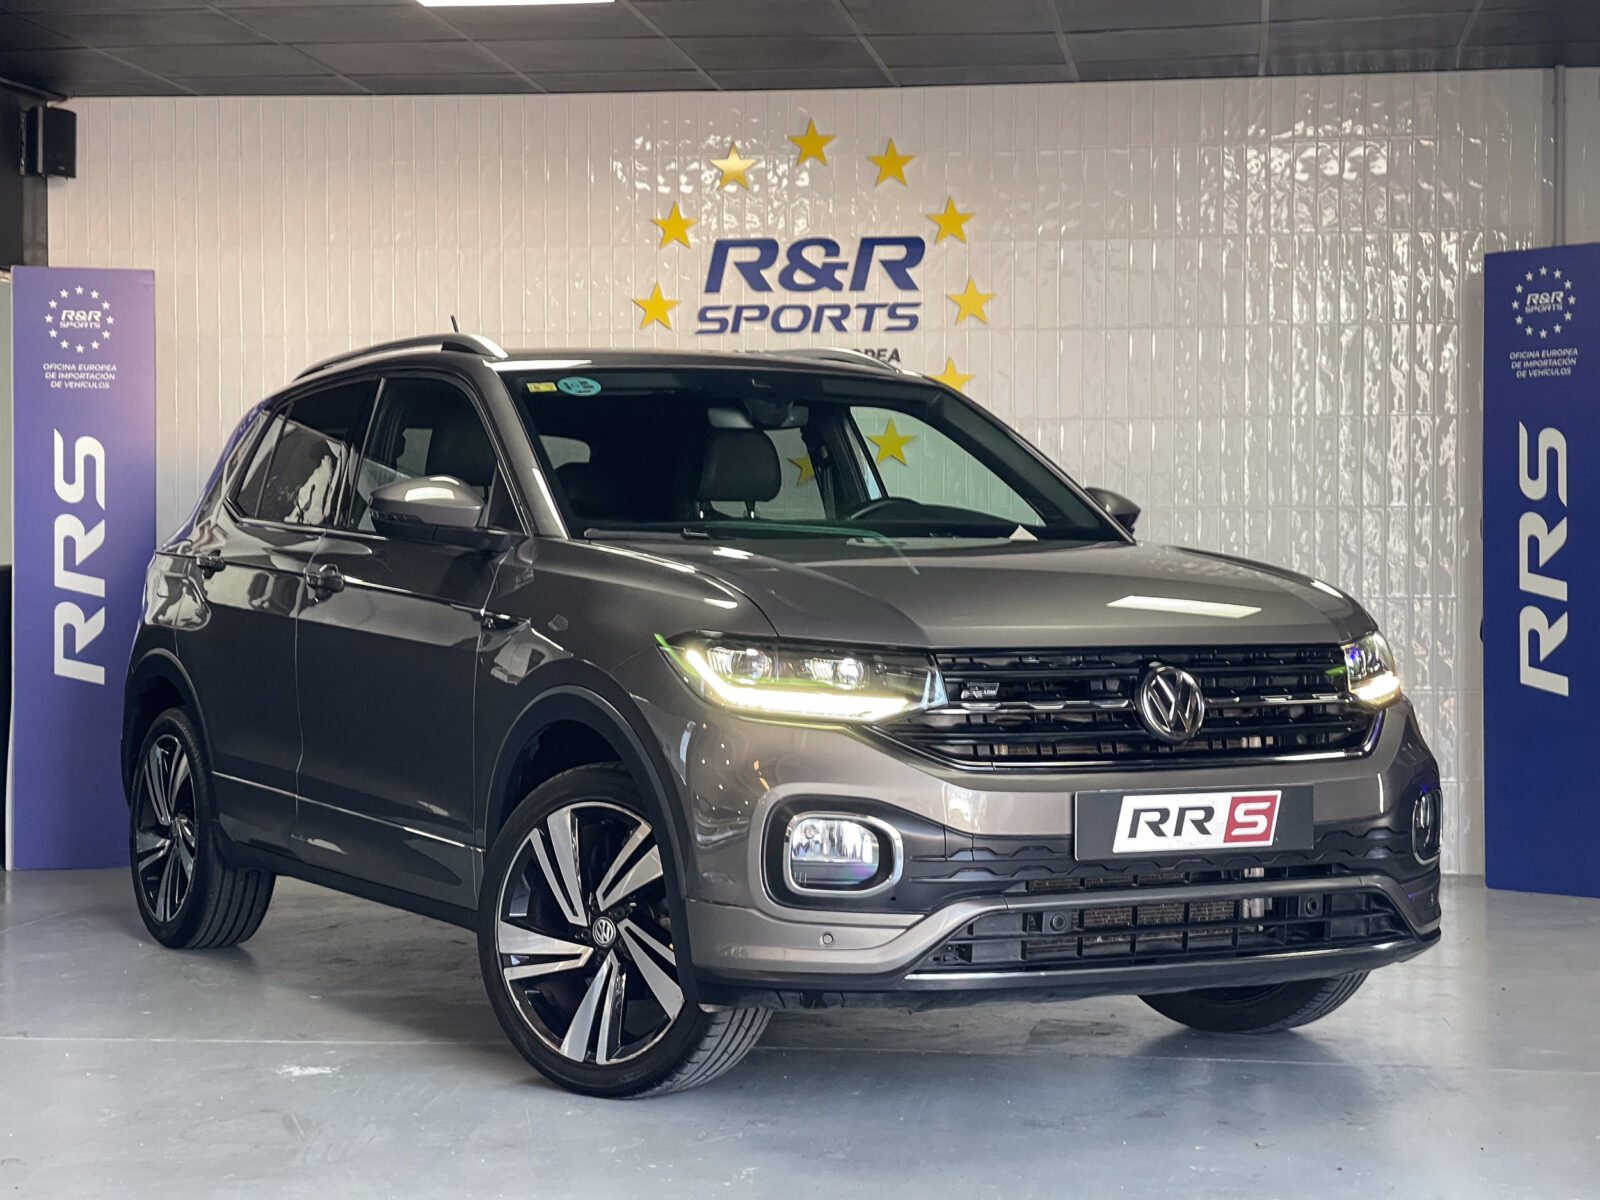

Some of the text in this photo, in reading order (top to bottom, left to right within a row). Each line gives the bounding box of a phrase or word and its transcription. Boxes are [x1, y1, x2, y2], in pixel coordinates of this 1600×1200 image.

[704, 236, 926, 293] R&R
[1527, 291, 1564, 305] R&R
[1525, 303, 1563, 313] SPORTS
[61, 309, 102, 322] R&R
[695, 302, 922, 335] SPORTS
[59, 321, 101, 329] SPORTS
[1509, 347, 1578, 360] OFICINA EUROPEA
[43, 363, 117, 372] OFICINA EUROPEA
[1511, 361, 1521, 369] DE
[58, 371, 115, 380] IMPORTACIÓN
[1516, 370, 1526, 378] DE
[50, 380, 110, 389] DE VEHÍCULOS
[54, 428, 105, 685] RRS
[1519, 421, 1569, 696] RRS
[1127, 801, 1271, 839] RRS
